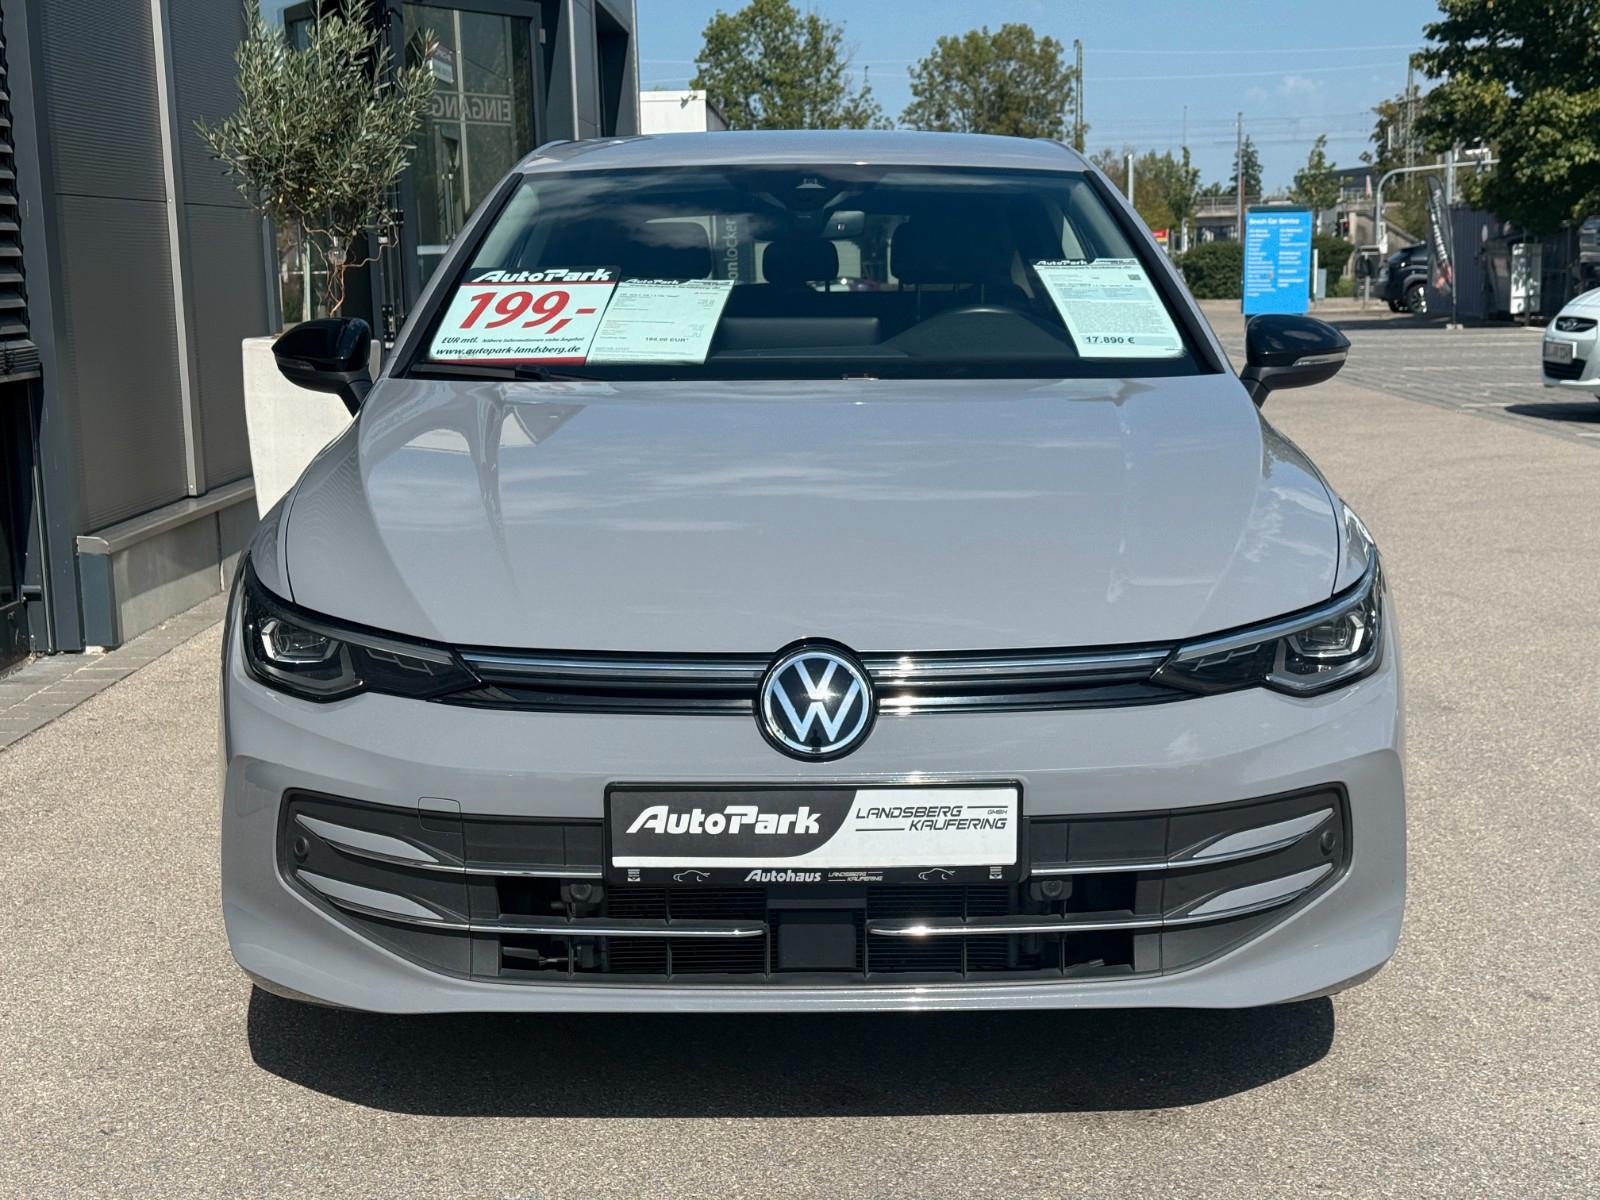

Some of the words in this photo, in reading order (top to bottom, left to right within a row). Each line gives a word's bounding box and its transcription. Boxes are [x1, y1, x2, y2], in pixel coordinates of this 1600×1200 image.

[471, 268, 613, 283] AutoPark
[459, 290, 597, 335] 199,-
[1086, 336, 1124, 344] 17.890
[1128, 336, 1135, 344] €
[436, 345, 581, 356] www.autopark-landsberg.de
[856, 806, 964, 819] LANDSBERG
[625, 805, 821, 835] AutoPark
[909, 818, 1008, 831] KAUFERING
[744, 869, 822, 882] Autohaus
